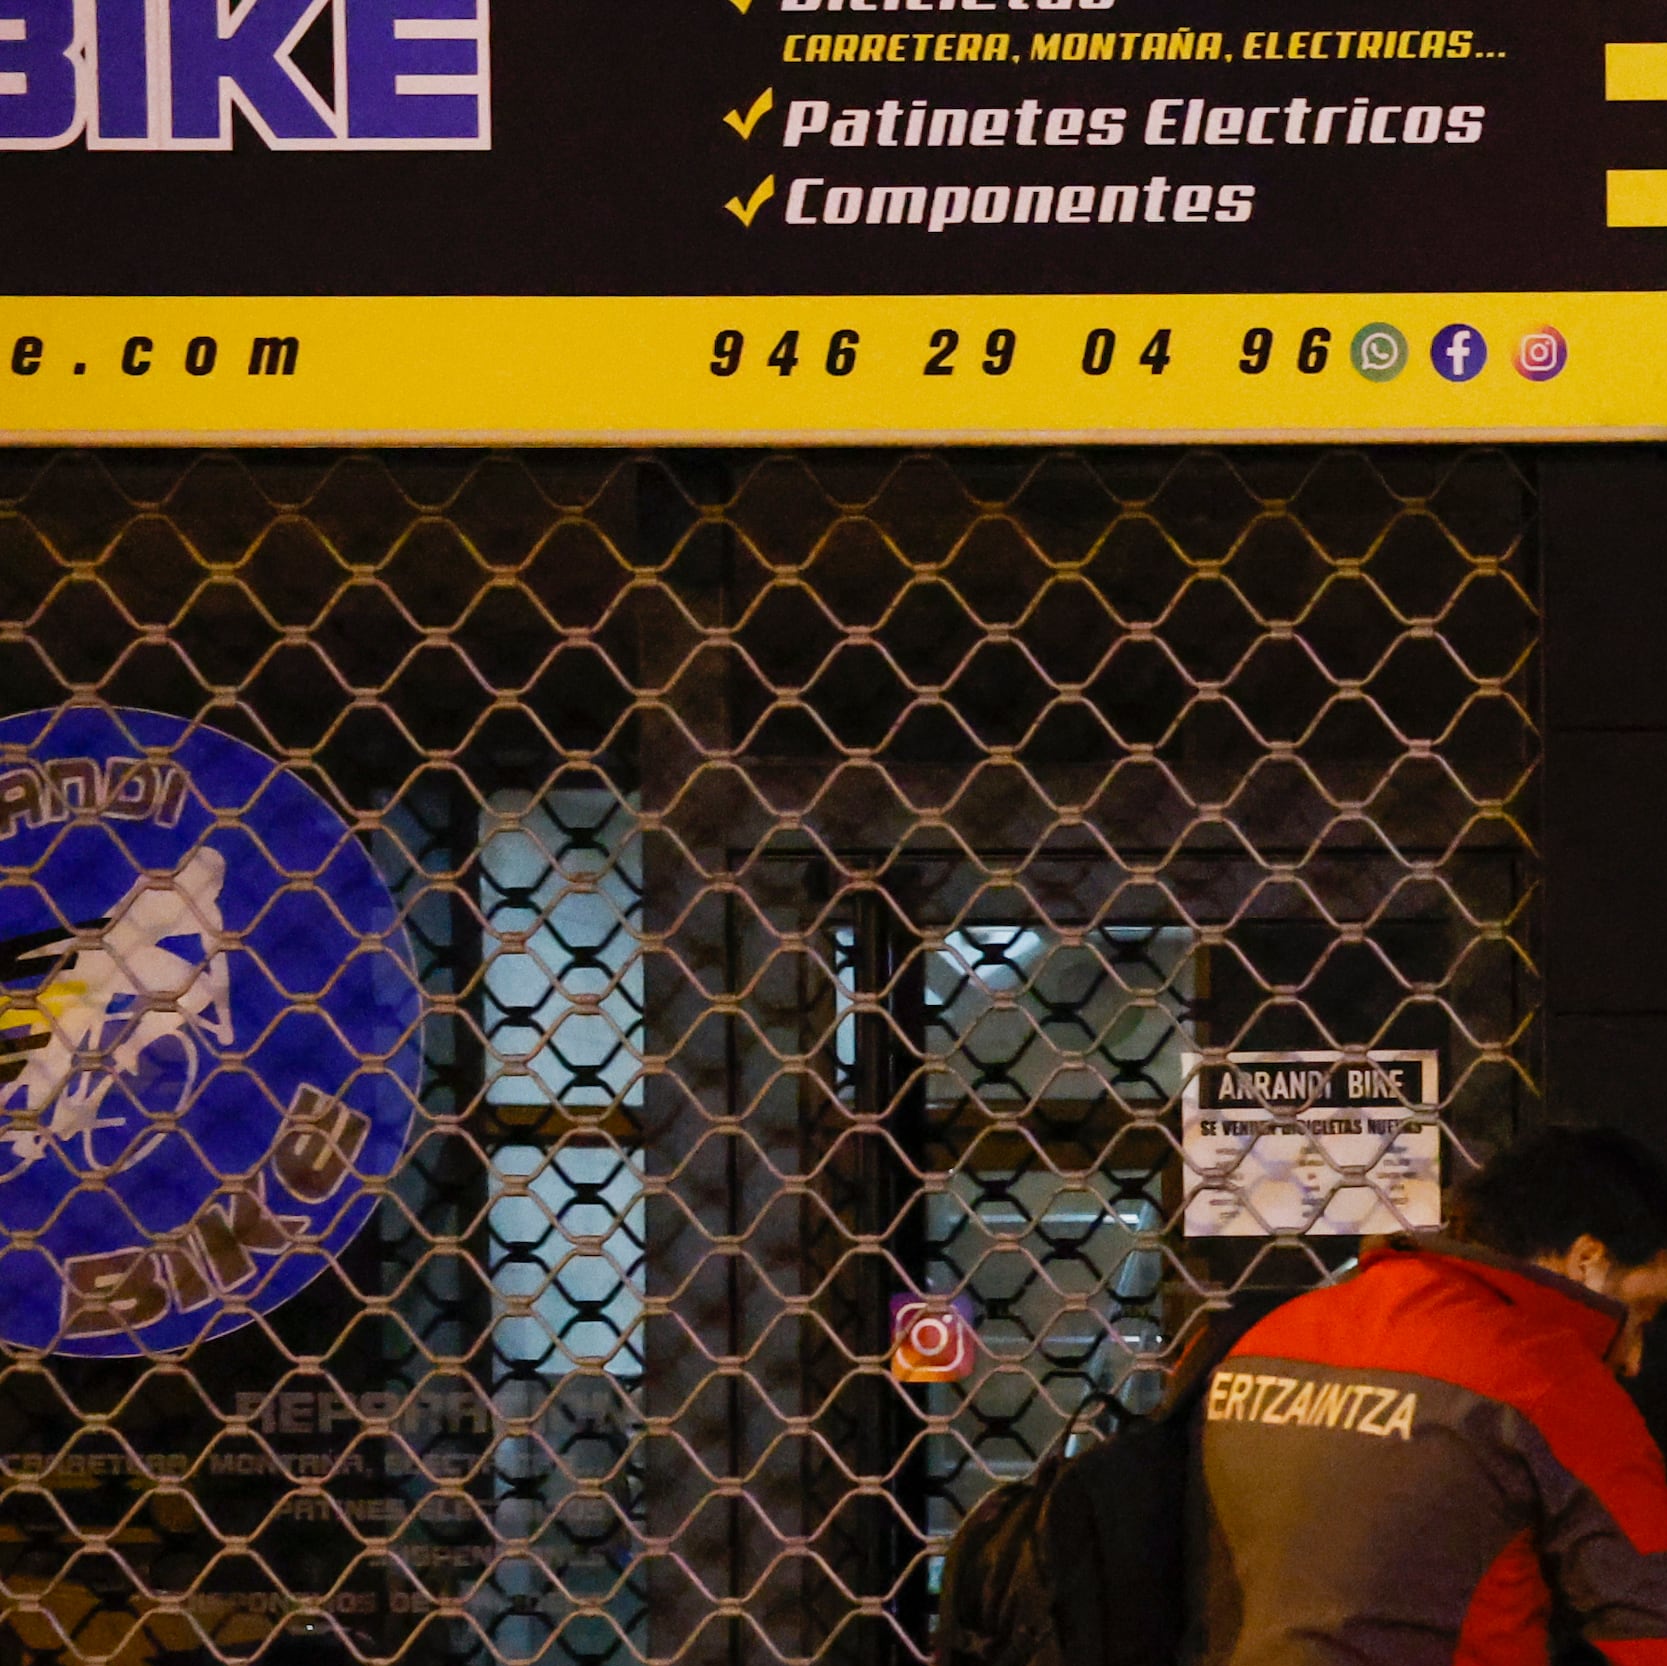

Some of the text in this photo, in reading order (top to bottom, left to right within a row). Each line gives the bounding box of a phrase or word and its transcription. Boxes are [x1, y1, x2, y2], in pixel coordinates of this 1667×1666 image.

[783, 28, 1507, 64] CARRETERA, MONTAÑA, ELECTRICAS...
[784, 97, 1486, 147] Patinetes Electricos
[786, 176, 1256, 232] Componentes
[710, 327, 1331, 377] 946 29 04 96
[1200, 1120, 1217, 1137] SE
[1207, 1371, 1417, 1440] ERTZAINTZA
